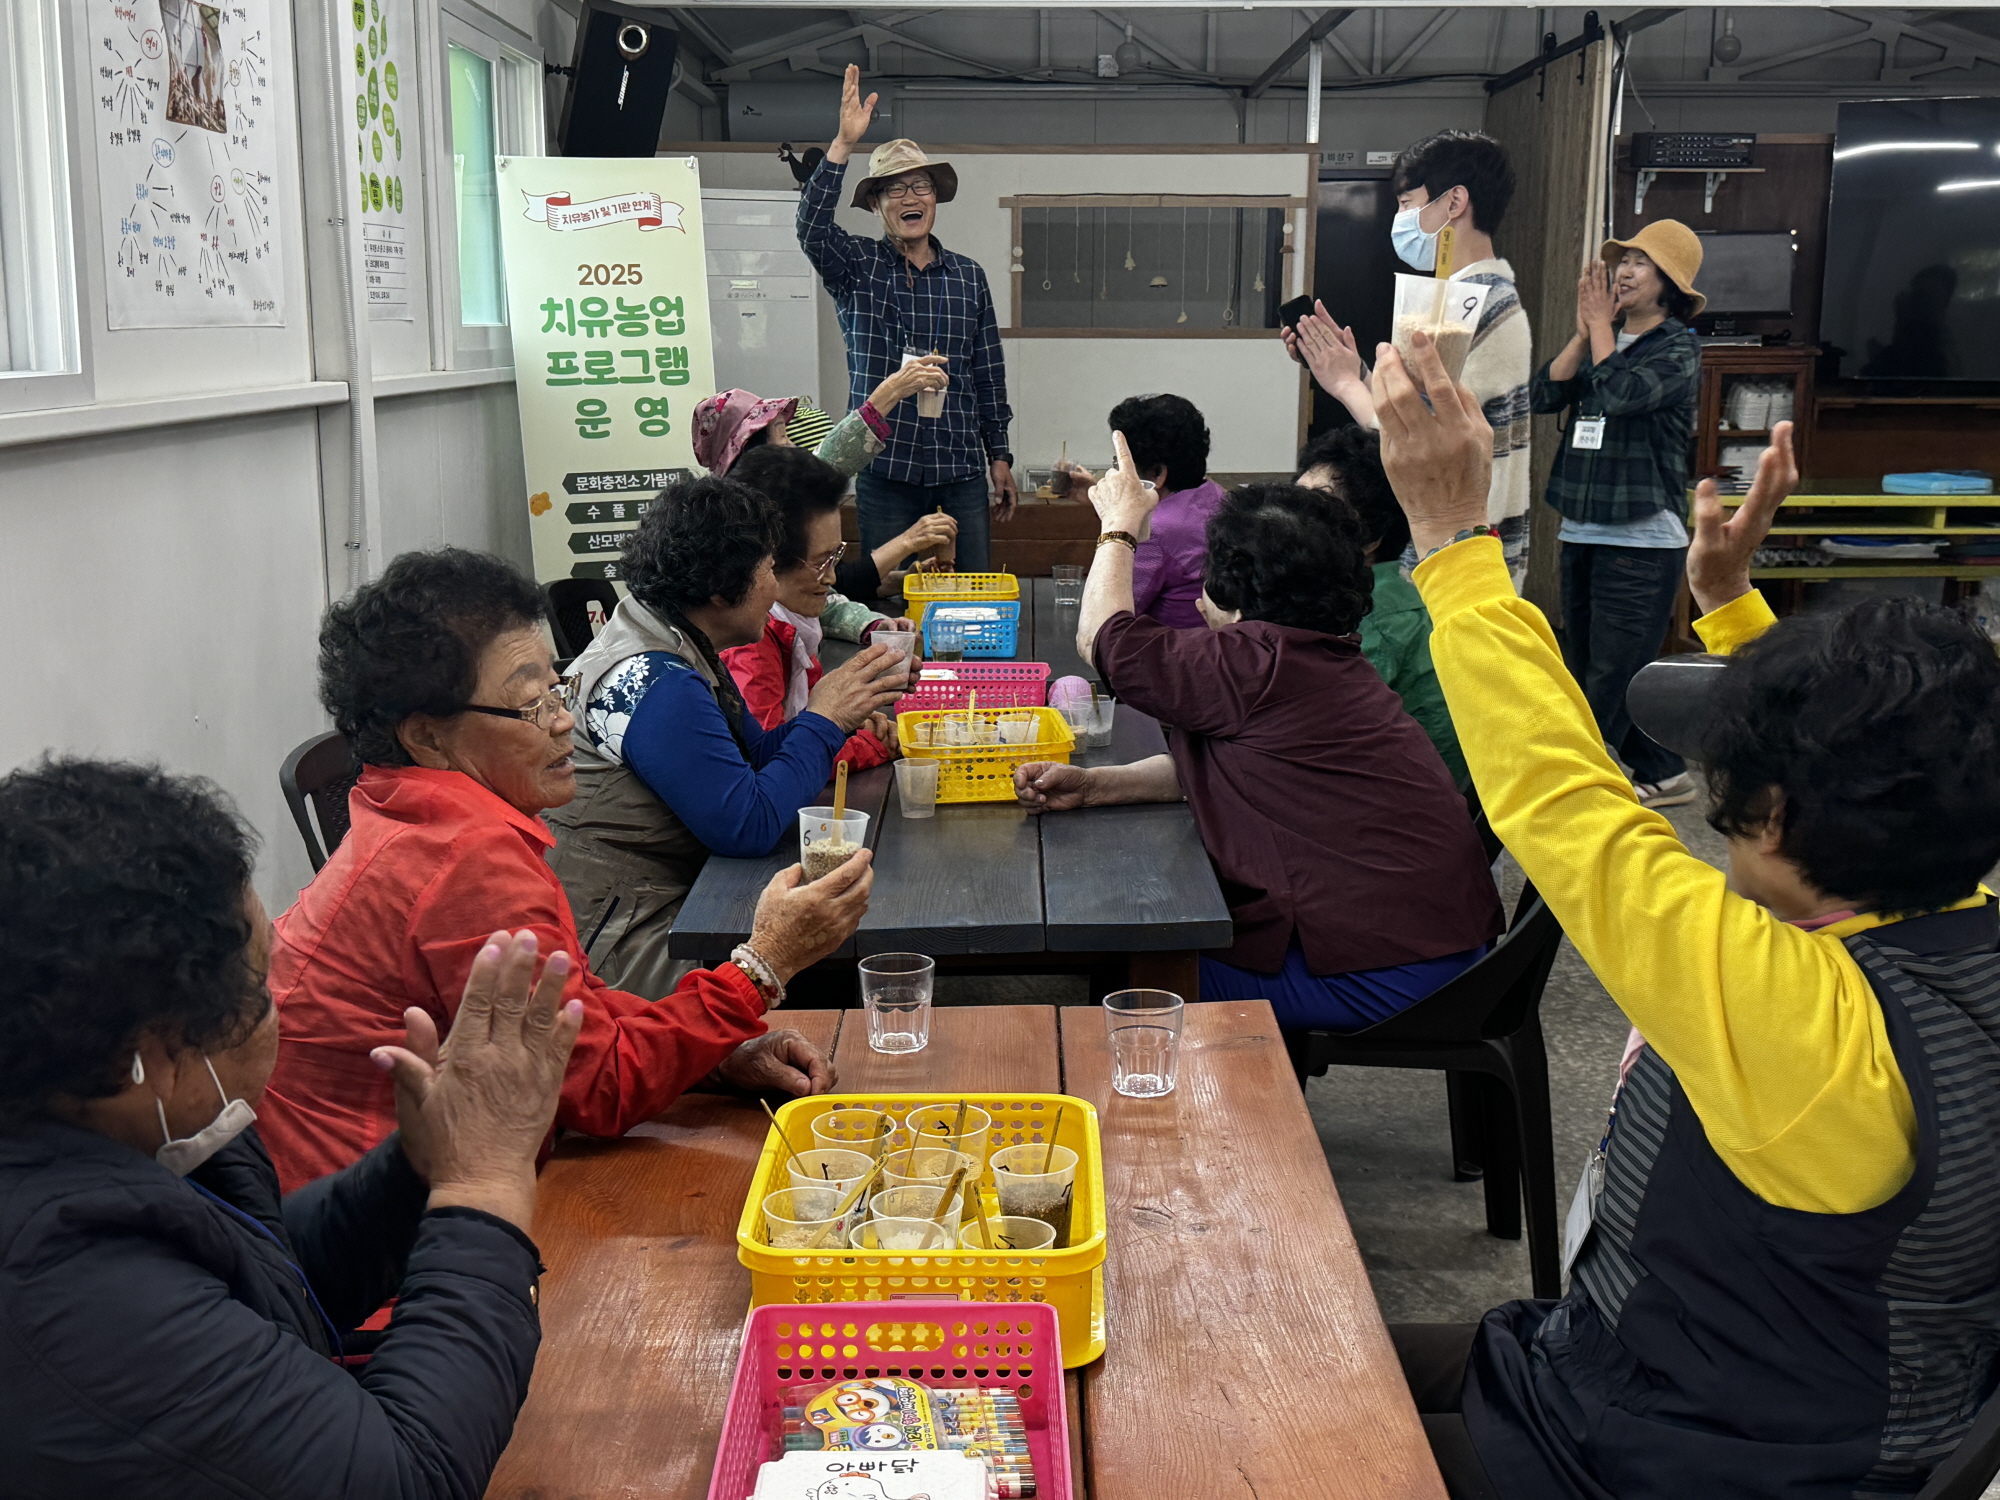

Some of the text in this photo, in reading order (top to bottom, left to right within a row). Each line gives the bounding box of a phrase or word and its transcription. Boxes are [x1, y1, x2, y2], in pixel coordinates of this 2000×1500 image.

[1327, 152, 1354, 162] 비상구
[562, 200, 652, 225] 치유농가 및 기관 연계
[577, 263, 643, 286] 2025
[540, 295, 686, 338] 치유농업
[1463, 296, 1478, 320] 9
[545, 346, 690, 387] 프로그램
[575, 475, 641, 492] 문화충전소
[603, 563, 617, 578] 숲
[820, 823, 827, 831] 6
[803, 829, 811, 847] 6
[825, 1458, 920, 1474] 아빠닭
